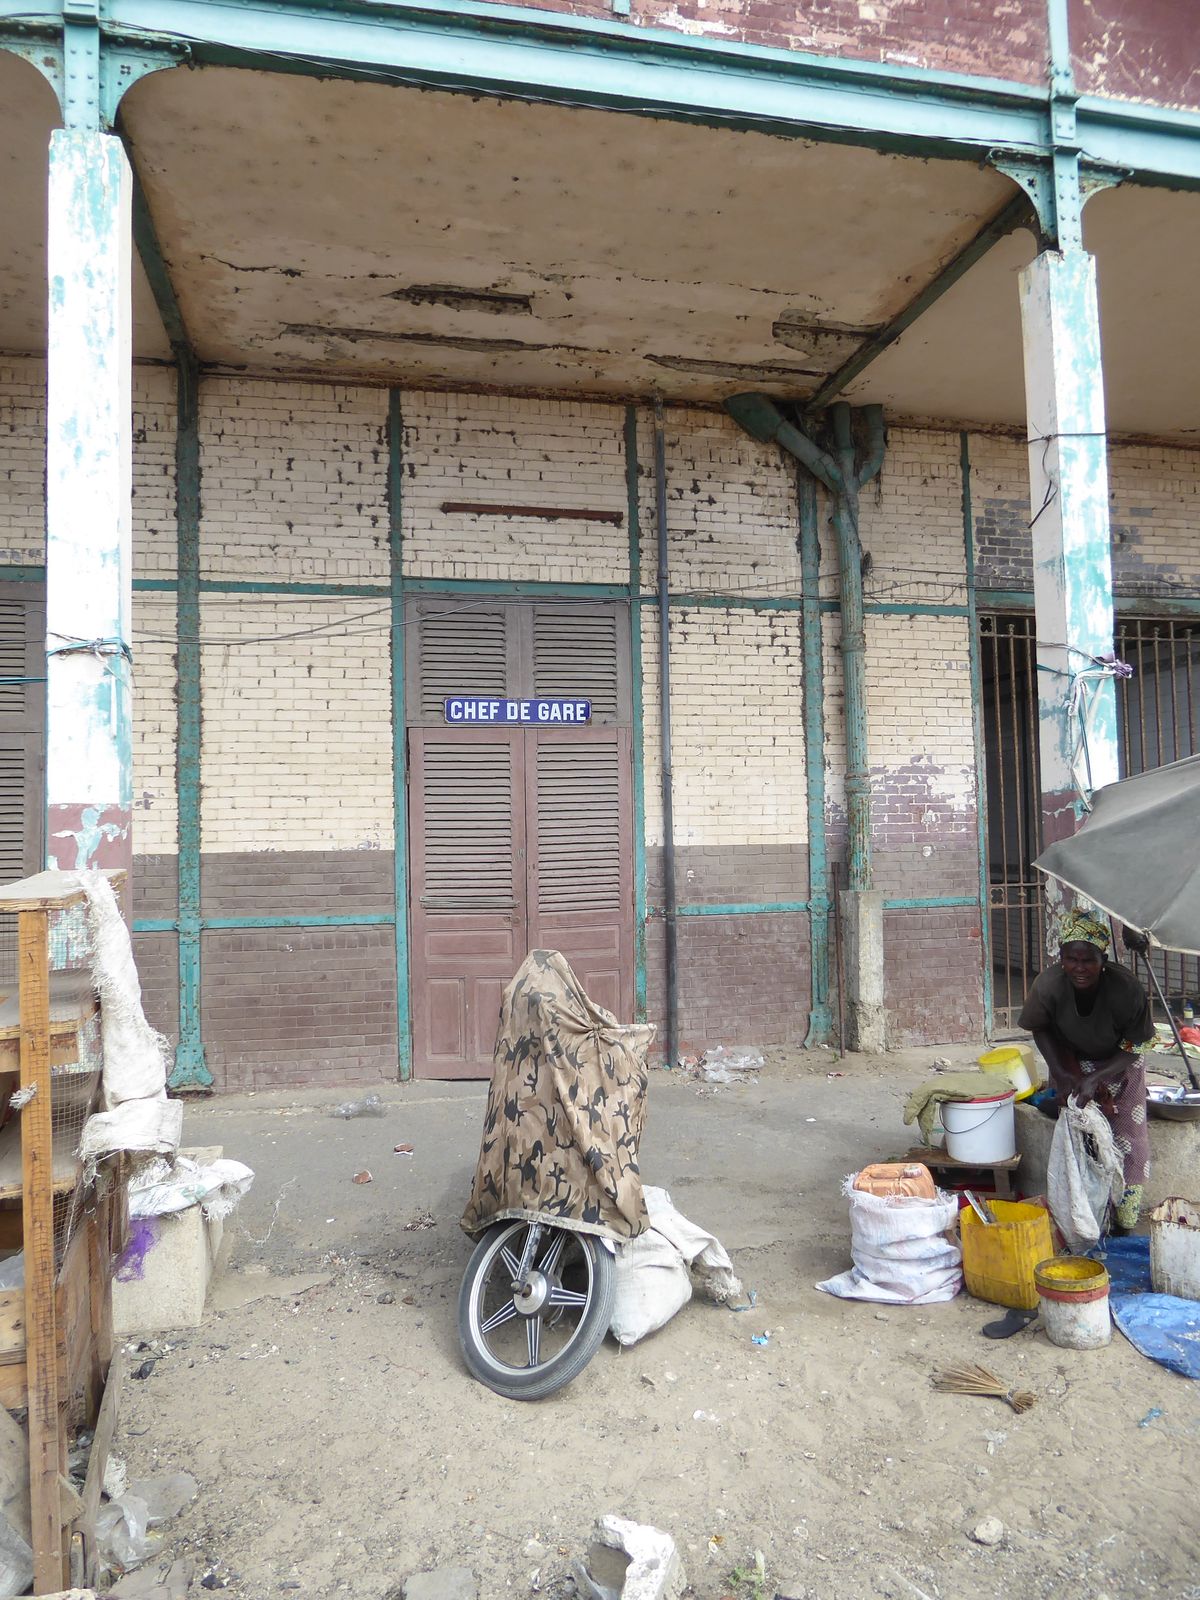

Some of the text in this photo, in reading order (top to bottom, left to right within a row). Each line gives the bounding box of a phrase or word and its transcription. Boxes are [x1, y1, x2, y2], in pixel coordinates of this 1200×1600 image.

[450, 701, 586, 721] CHEF DE GARE
